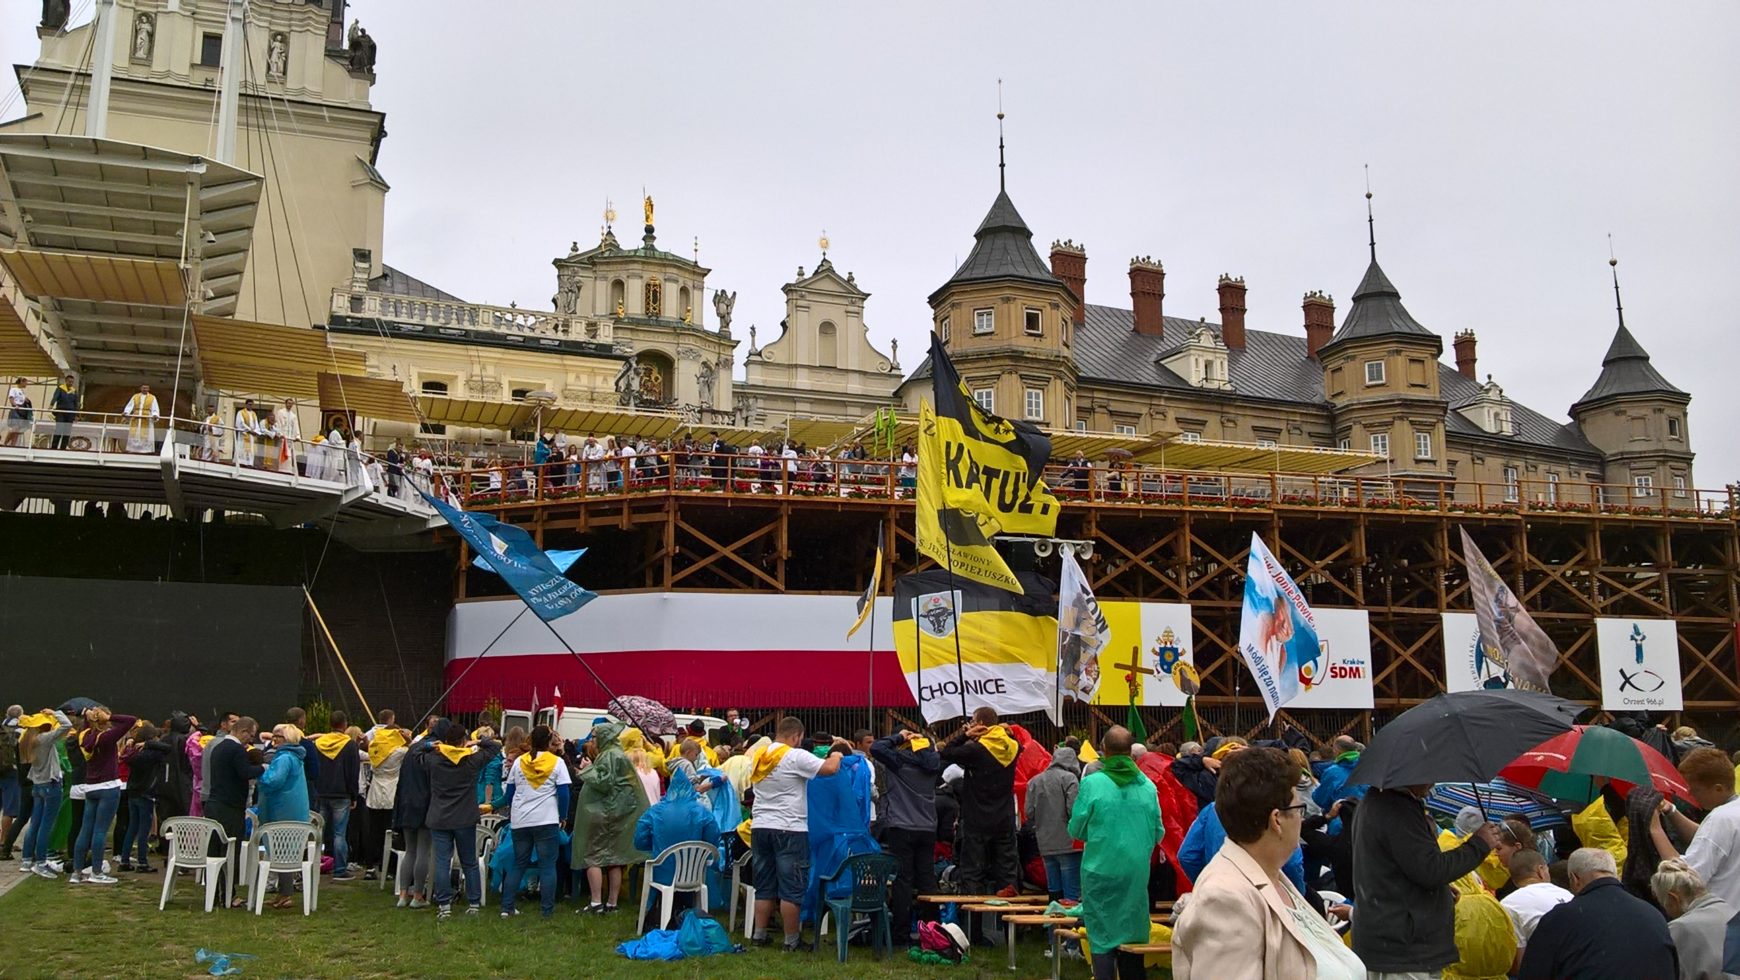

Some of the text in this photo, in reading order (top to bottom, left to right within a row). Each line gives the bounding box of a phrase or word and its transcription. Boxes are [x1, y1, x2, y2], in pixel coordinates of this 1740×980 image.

[1272, 571, 1294, 597] Janie
[1292, 594, 1314, 623] Pawle
[1257, 664, 1270, 679] się
[1330, 662, 1361, 679] ŚDM
[1263, 675, 1273, 687] za
[920, 678, 1007, 702] CHOJNICE
